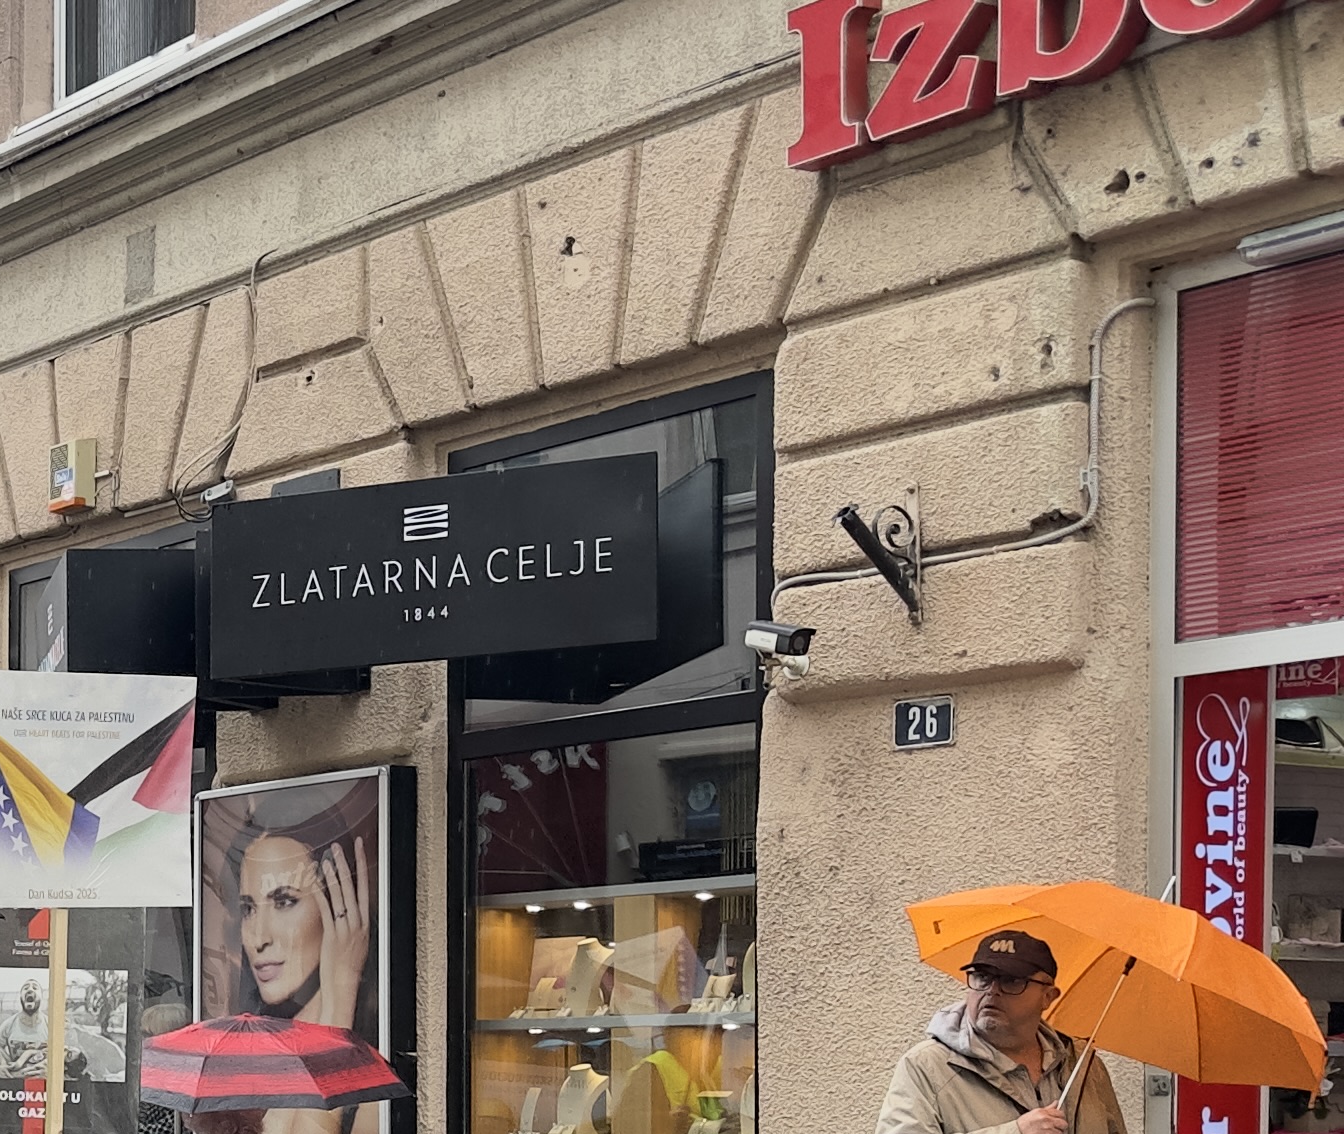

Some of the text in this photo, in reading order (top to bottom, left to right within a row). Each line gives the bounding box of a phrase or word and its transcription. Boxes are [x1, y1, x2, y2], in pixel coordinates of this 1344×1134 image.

[252, 536, 614, 609] ZLATARNA CELJE
[403, 605, 450, 623] 1844
[1, 706, 23, 721] NAŠE
[49, 710, 72, 722] KUCA
[74, 711, 86, 721] ZA
[89, 711, 135, 723] PALESTINU
[907, 704, 938, 741] 26
[1234, 769, 1250, 852] beauty
[1234, 857, 1246, 883] of
[28, 888, 45, 900] Dan
[47, 888, 74, 900] Kudsa
[70, 1092, 81, 1104] U
